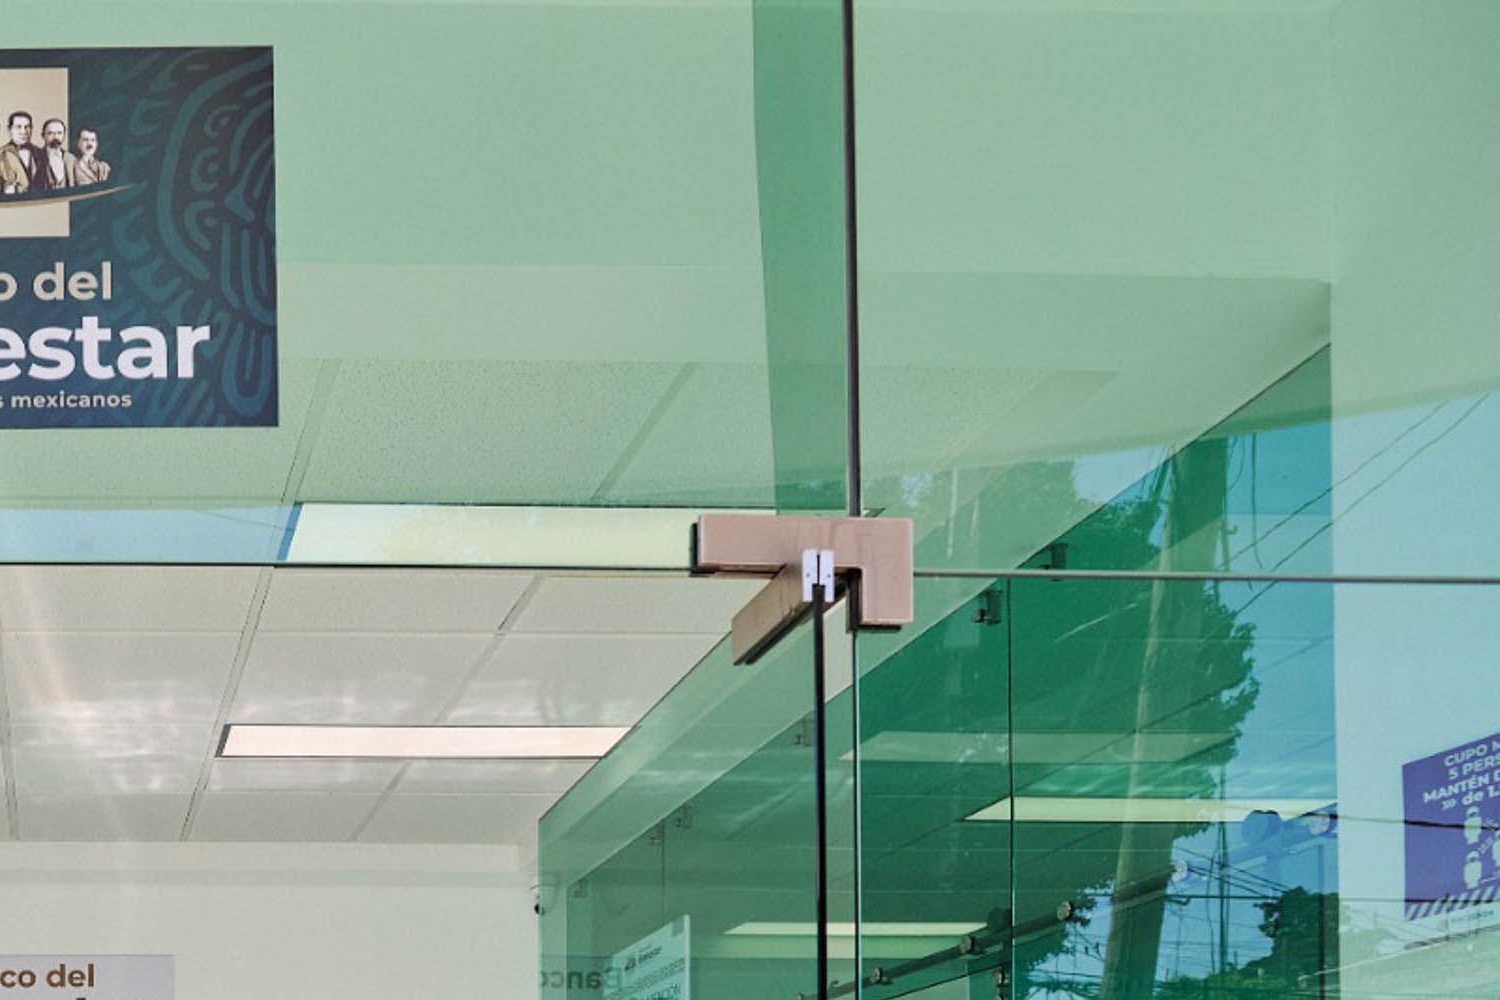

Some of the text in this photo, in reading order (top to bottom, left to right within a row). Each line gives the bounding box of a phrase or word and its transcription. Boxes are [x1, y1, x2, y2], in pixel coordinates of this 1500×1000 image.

[32, 262, 112, 301] del
[11, 391, 133, 409] mexicanos
[1444, 744, 1487, 766] CUPO
[1449, 767, 1458, 780] 5
[1423, 773, 1489, 803] MANTÉN
[1462, 791, 1484, 805] de
[46, 963, 95, 988] del
